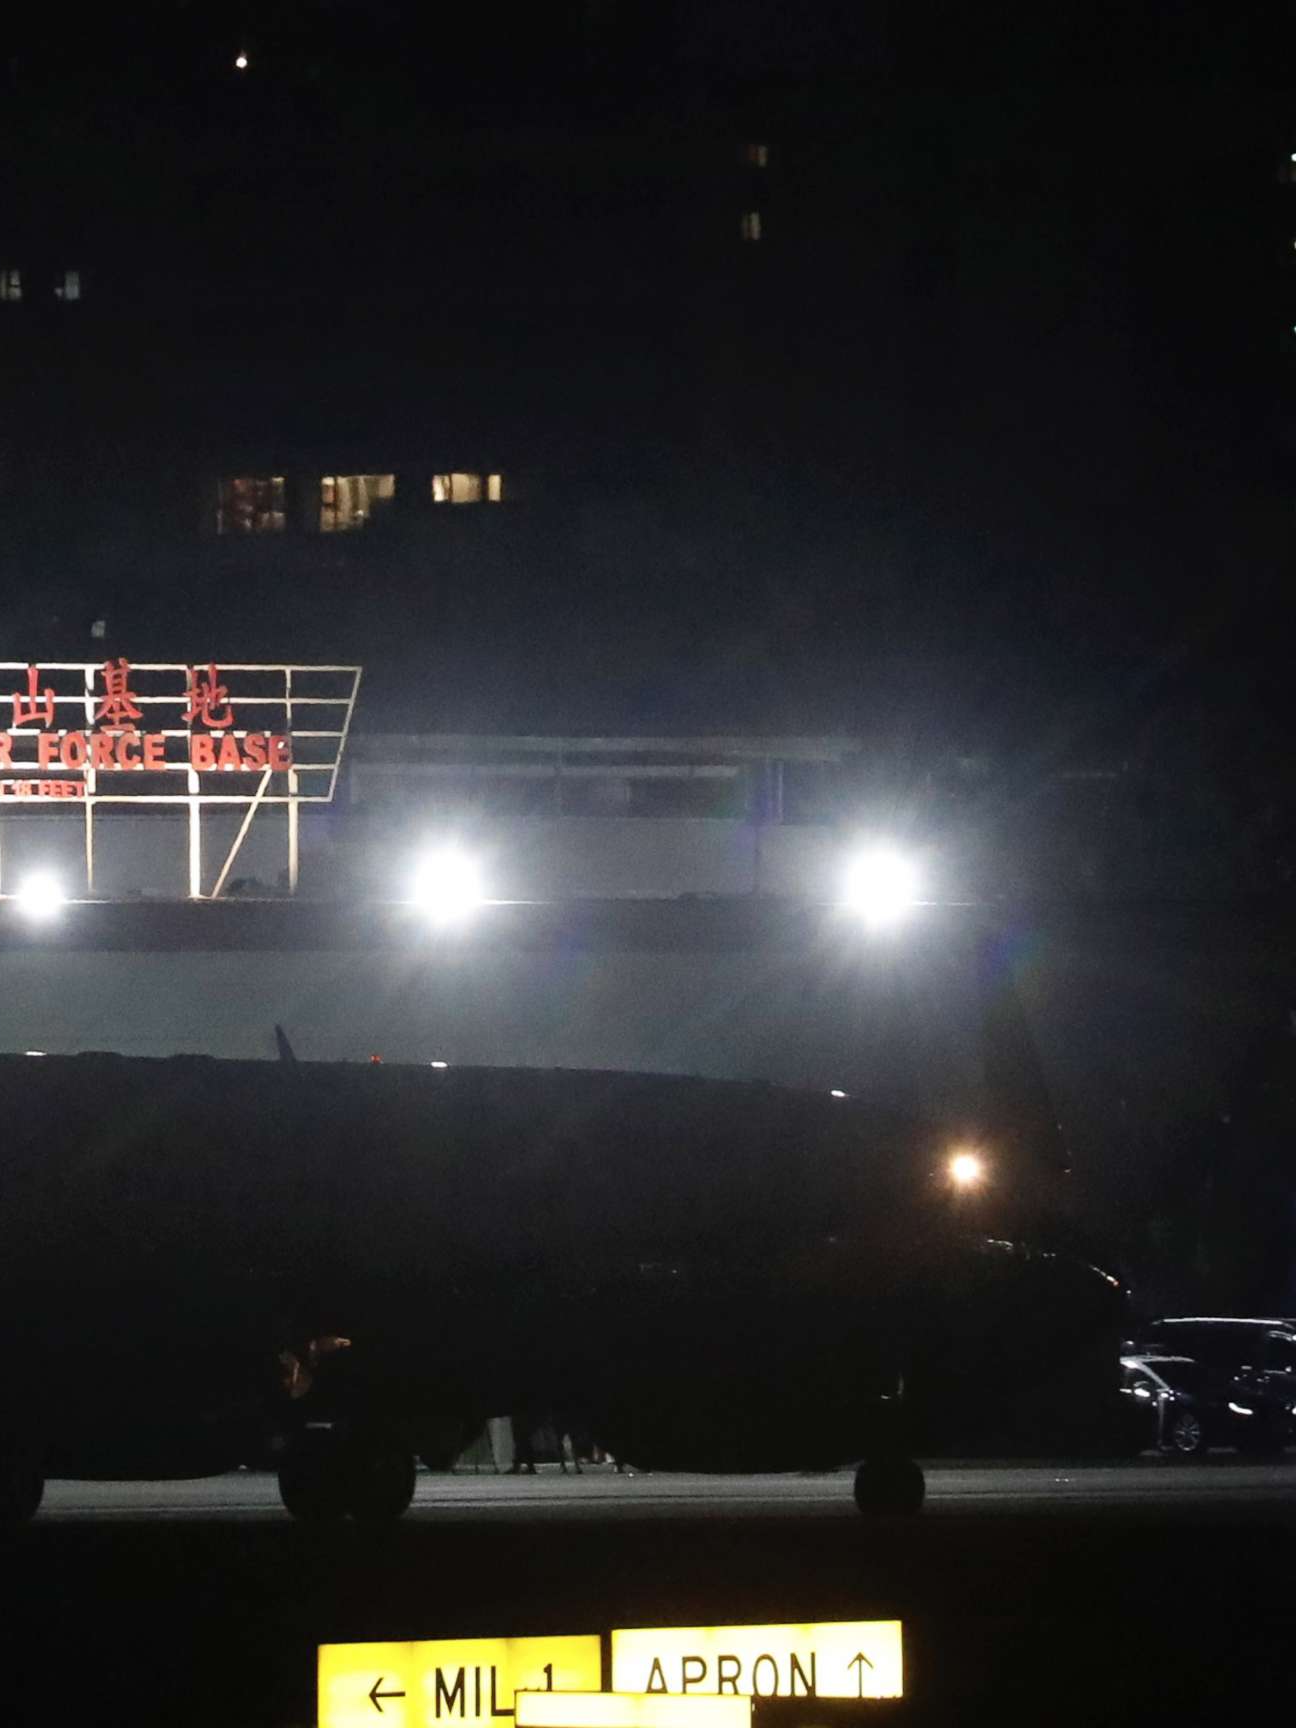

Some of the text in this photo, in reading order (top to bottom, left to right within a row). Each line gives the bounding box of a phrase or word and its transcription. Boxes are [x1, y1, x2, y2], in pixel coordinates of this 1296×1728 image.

[38, 731, 166, 770] FORCE
[191, 733, 294, 770] BASE
[38, 780, 86, 797] FEET
[435, 1665, 515, 1718] MIL
[645, 1652, 817, 1697] APRON
